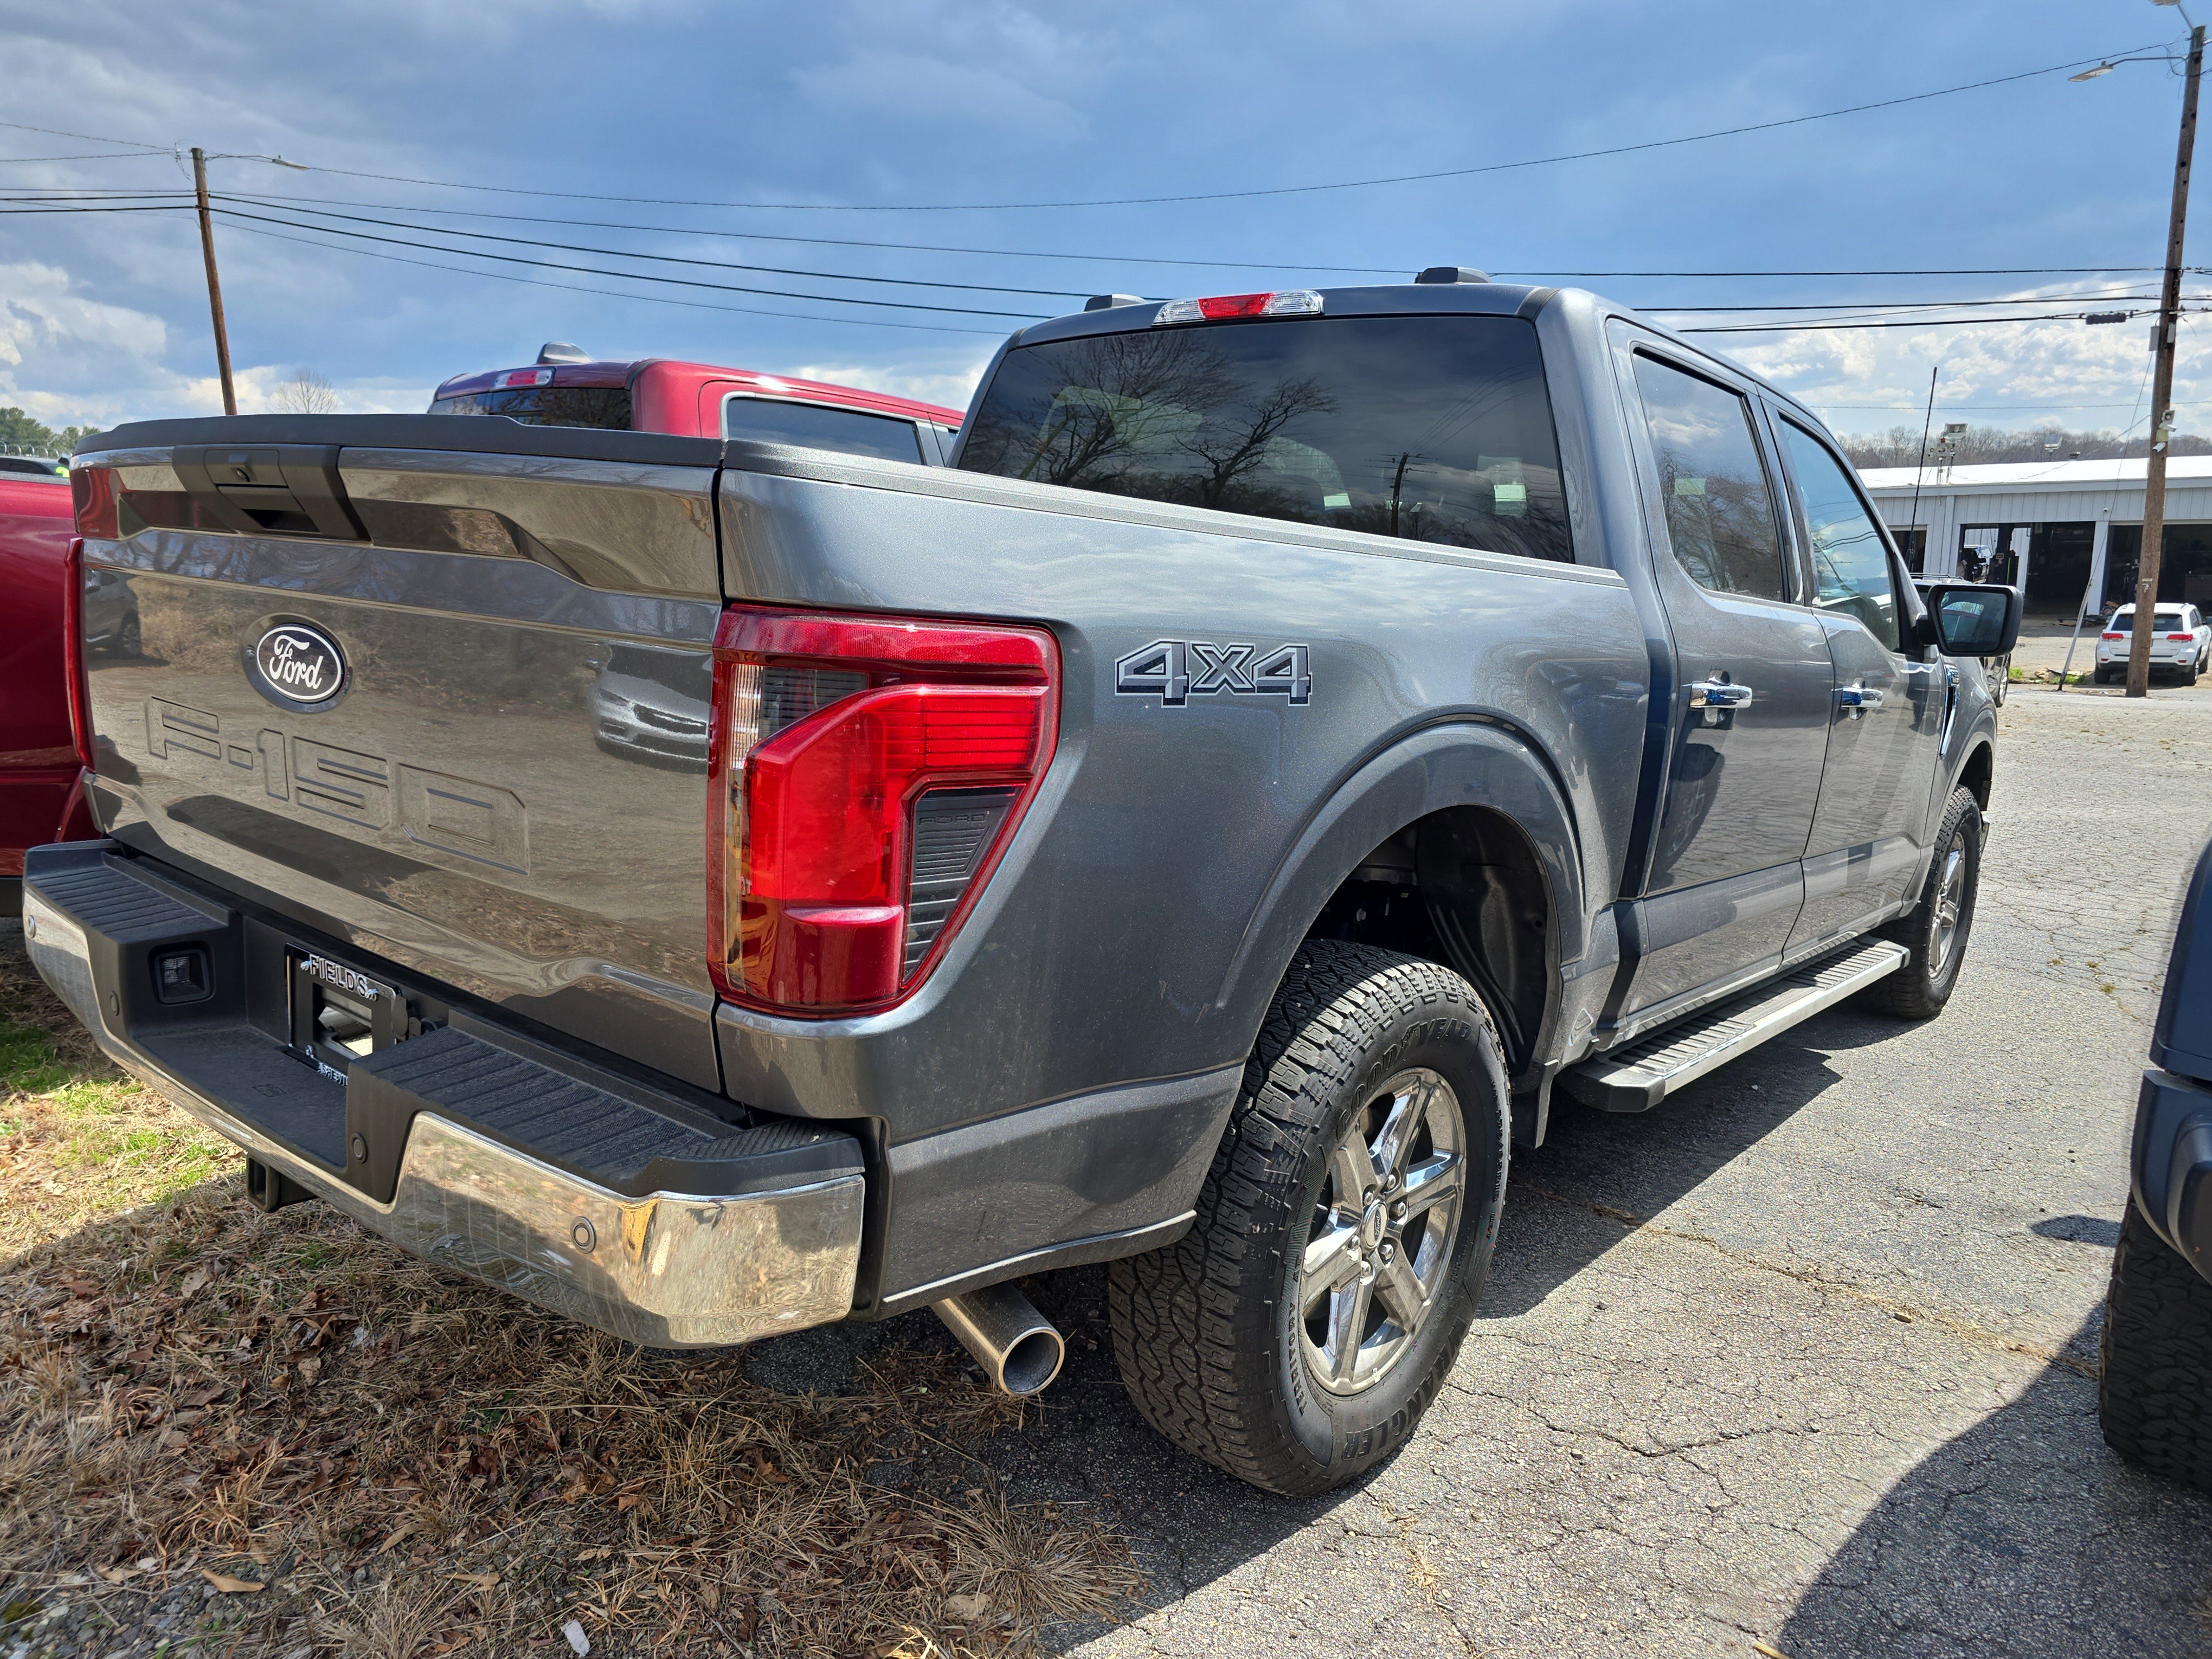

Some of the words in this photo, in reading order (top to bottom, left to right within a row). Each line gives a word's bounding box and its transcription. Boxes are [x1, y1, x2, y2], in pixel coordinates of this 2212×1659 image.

[269, 634, 323, 690] Ford
[144, 696, 530, 876] F-150
[918, 814, 986, 827] FORD
[309, 953, 369, 998] FIELDS
[1288, 1302, 1308, 1416] TERRITORY
[1341, 1315, 1468, 1461] WRANGLER
